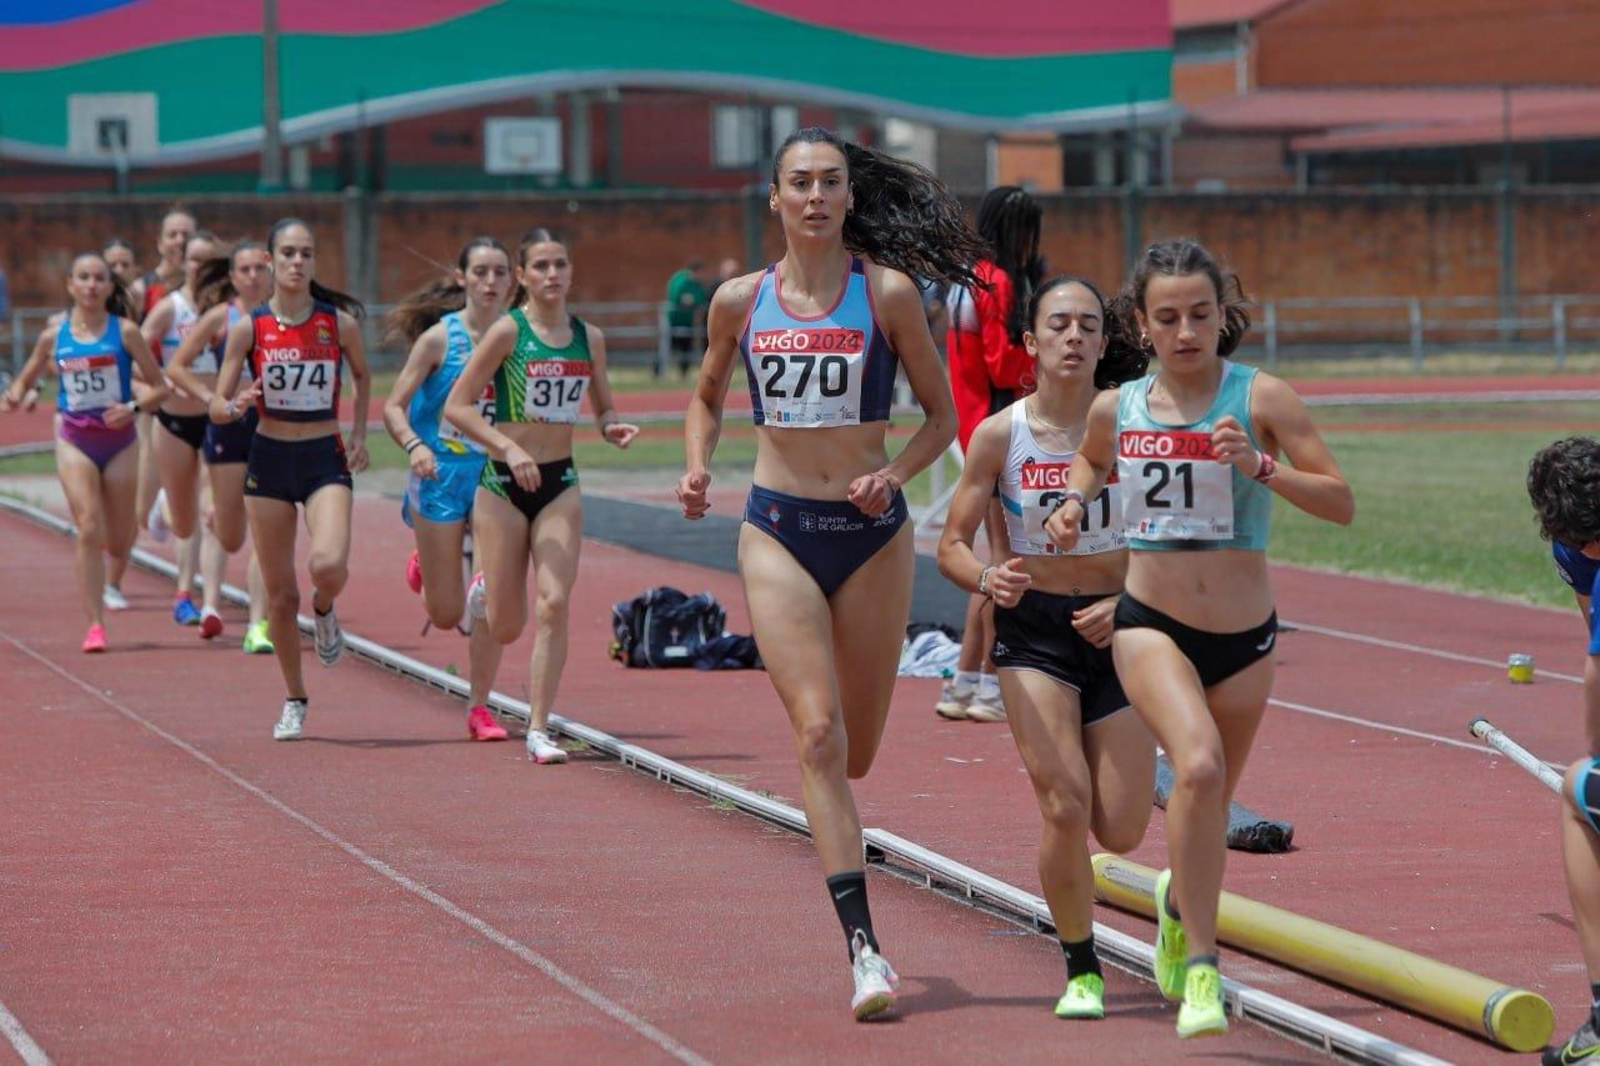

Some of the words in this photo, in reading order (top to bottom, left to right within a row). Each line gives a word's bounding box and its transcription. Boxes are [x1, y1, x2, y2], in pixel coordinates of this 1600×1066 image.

[73, 369, 106, 394] 55
[267, 363, 327, 391] 374
[761, 354, 848, 398] 270
[532, 378, 584, 407] 314
[1122, 434, 1213, 456] VIGO202
[1142, 461, 1194, 509] 21
